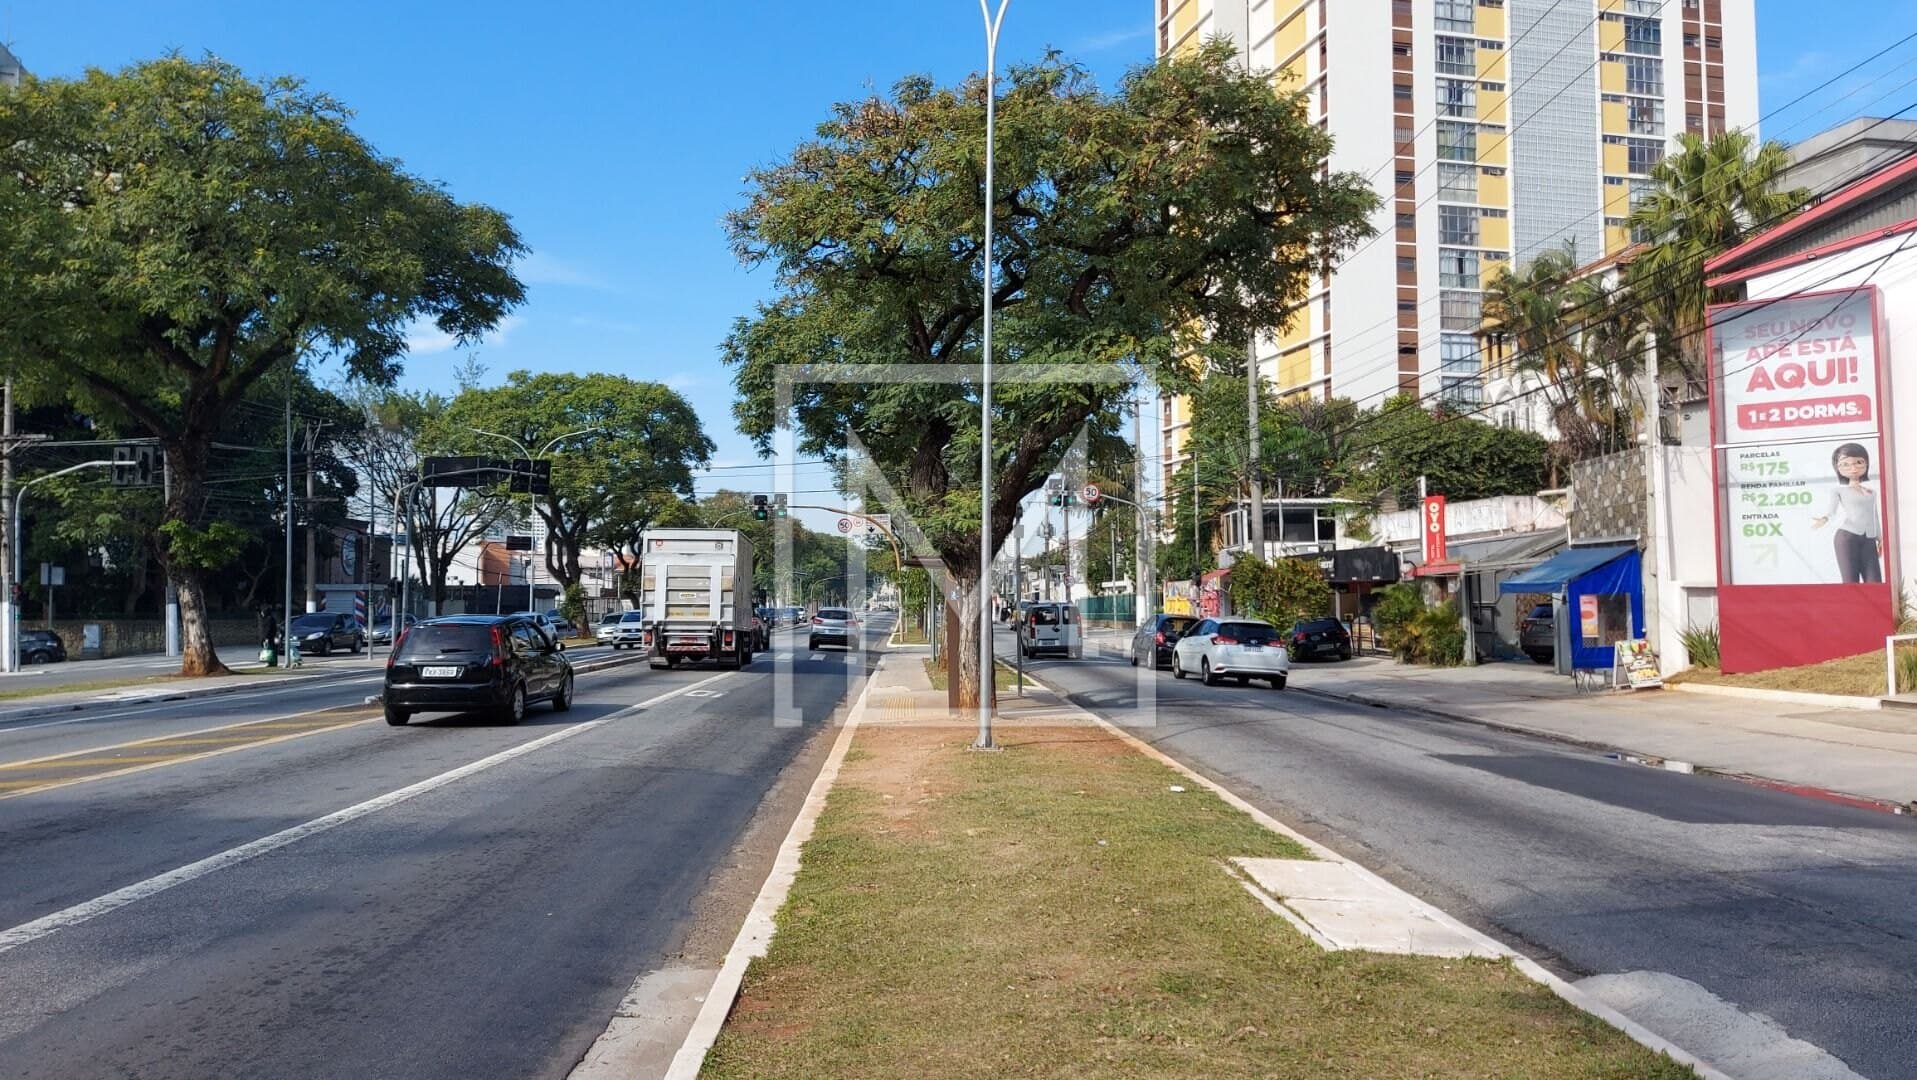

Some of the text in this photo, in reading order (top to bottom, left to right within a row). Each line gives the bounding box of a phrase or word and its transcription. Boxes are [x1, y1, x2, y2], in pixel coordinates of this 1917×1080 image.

[1744, 313, 1856, 339] SEU NOVO
[1746, 330, 1857, 361] APÊ ESTÁ
[1745, 356, 1858, 392] AQUI!
[1748, 410, 1757, 423] 1
[1768, 408, 1781, 422] 2
[1784, 401, 1862, 421] DORMS.
[1740, 451, 1780, 459] PARCELAS
[1085, 487, 1097, 497] 50
[1429, 502, 1440, 533] OYO
[1743, 522, 1783, 537] 60X
